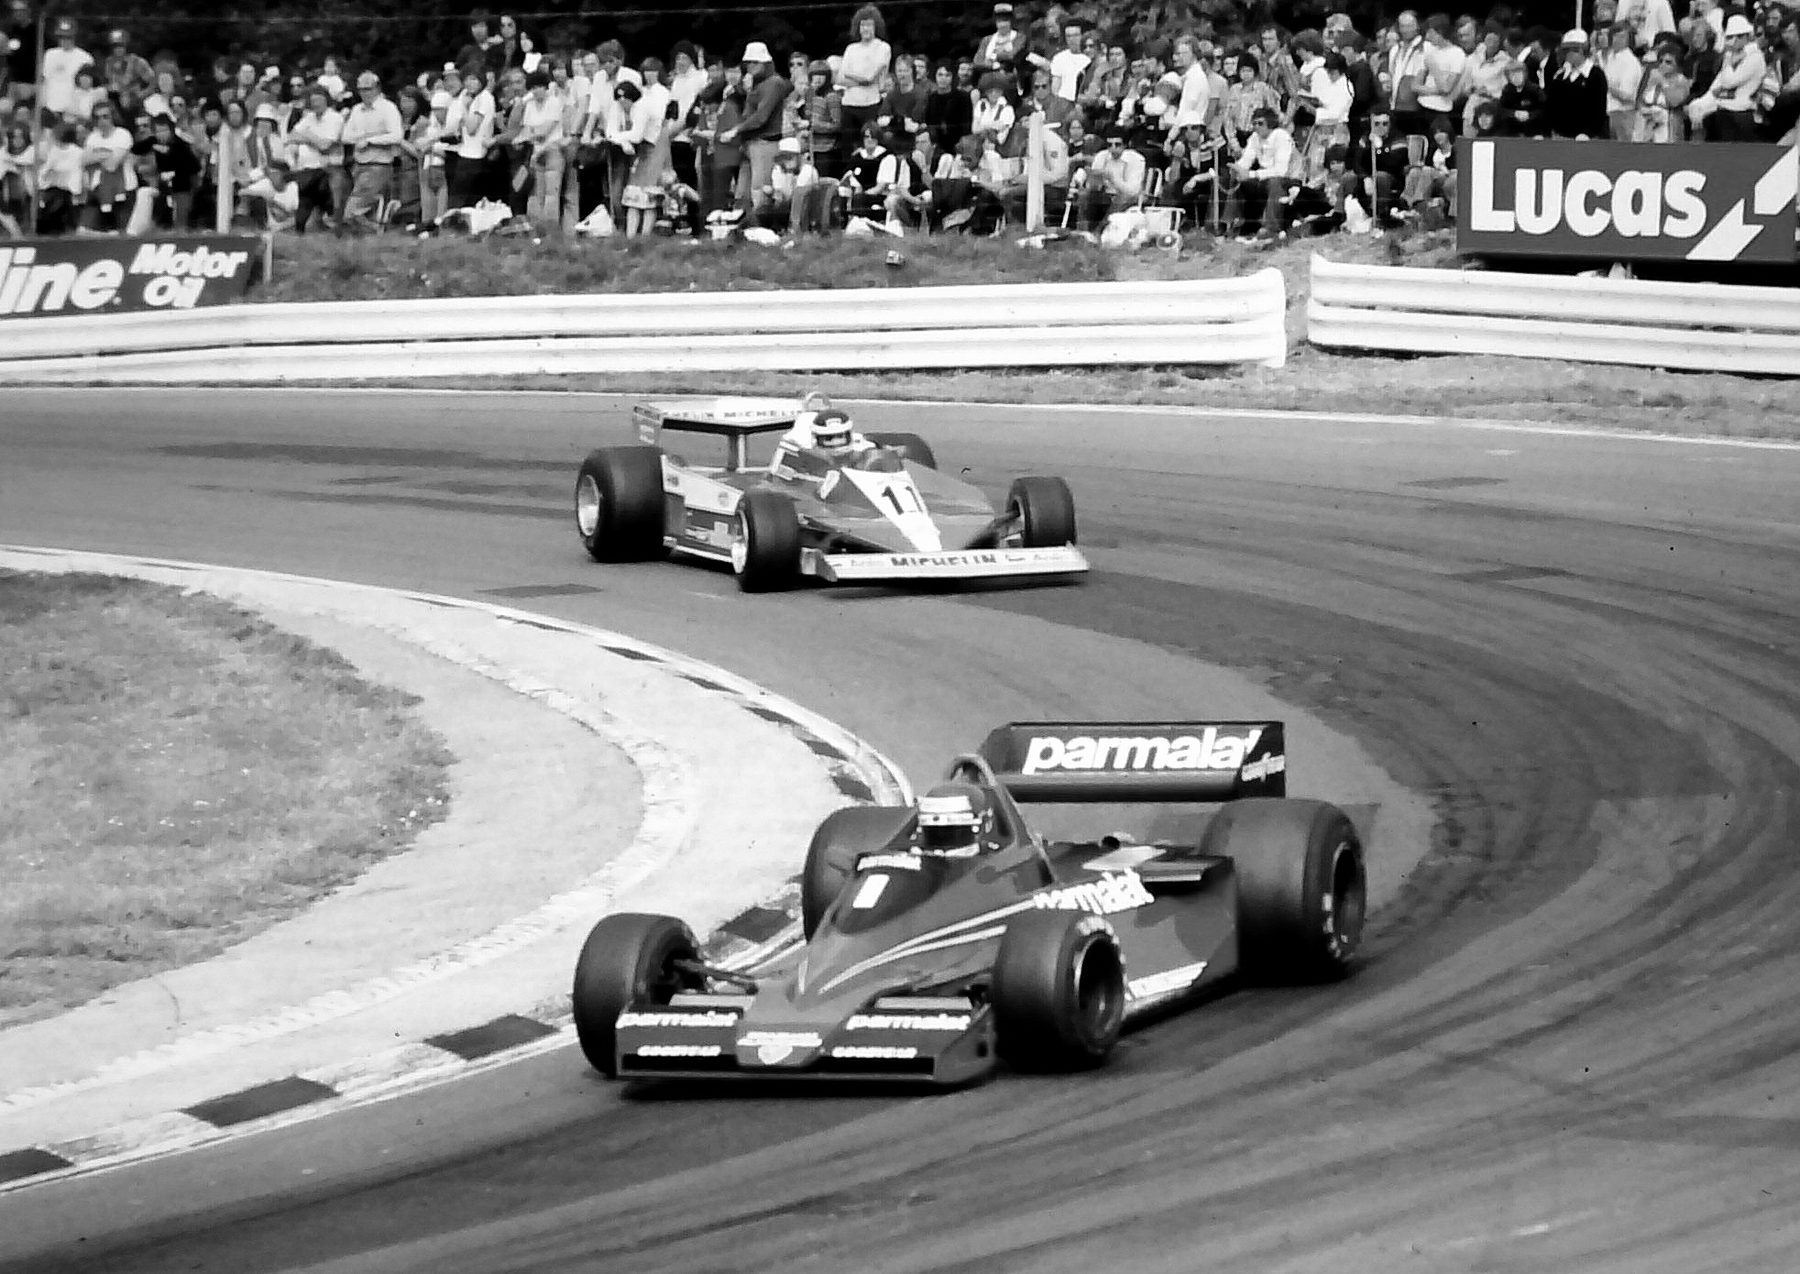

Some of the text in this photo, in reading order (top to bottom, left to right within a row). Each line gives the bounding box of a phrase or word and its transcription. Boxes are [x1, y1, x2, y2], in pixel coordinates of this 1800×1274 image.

[1471, 141, 1707, 238] Lucas
[0, 246, 124, 314] ine.
[129, 243, 248, 278] Motor
[881, 485, 923, 516] 11
